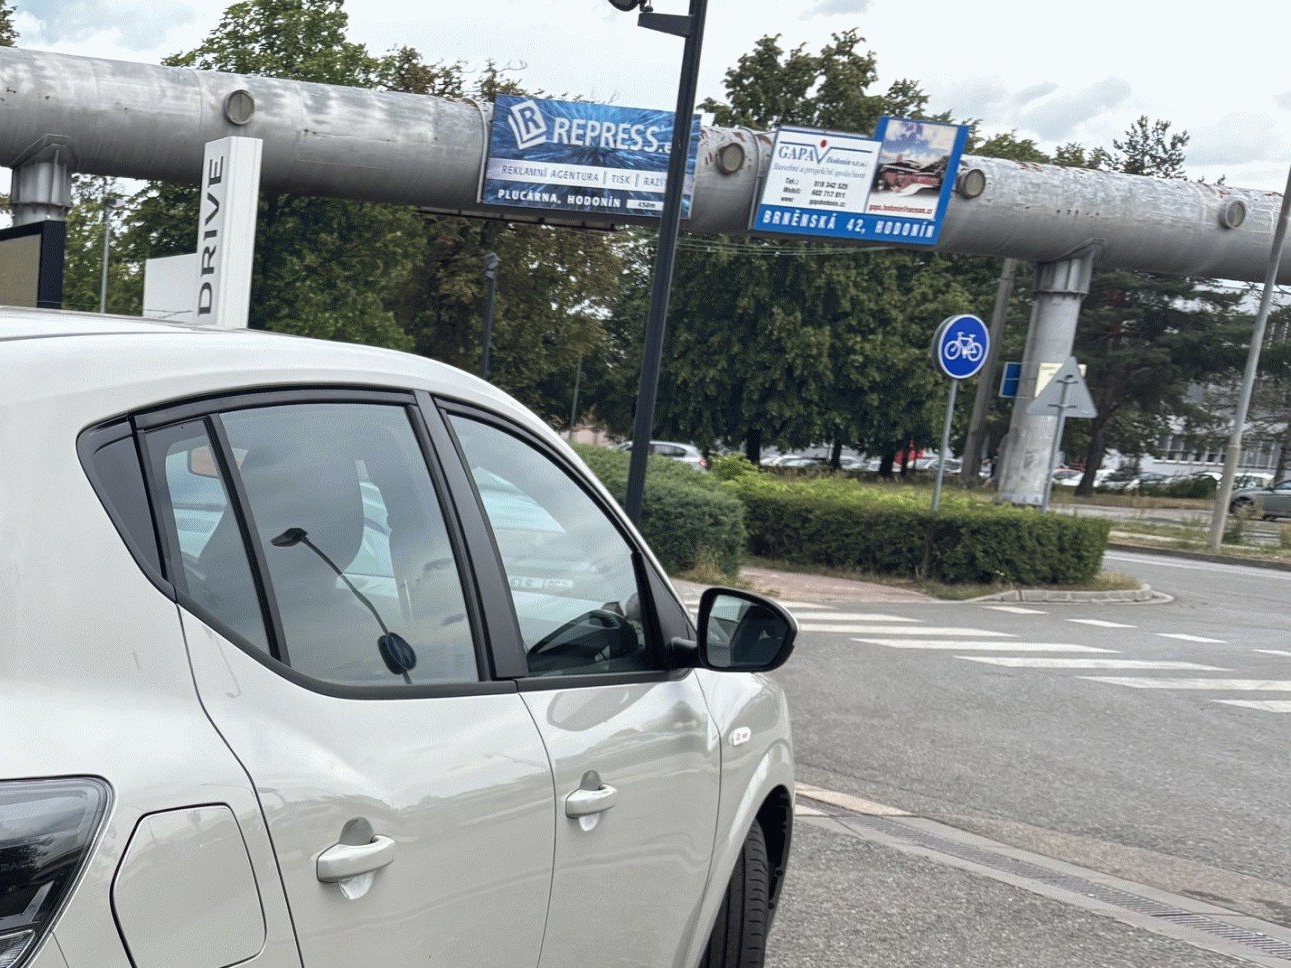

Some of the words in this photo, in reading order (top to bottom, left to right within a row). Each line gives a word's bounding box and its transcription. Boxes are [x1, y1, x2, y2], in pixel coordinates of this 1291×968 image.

[553, 117, 672, 154] REPRESS.e
[501, 165, 548, 179] REKLAMNÍ
[550, 170, 599, 182] AGENTURA
[611, 173, 630, 185] TISK
[567, 195, 621, 208] HODONÍN
[198, 156, 224, 317] DRIVE
[763, 209, 836, 230] BRNĚNSKÁ
[846, 218, 866, 234] 42,
[875, 219, 935, 238] HODONÍN
